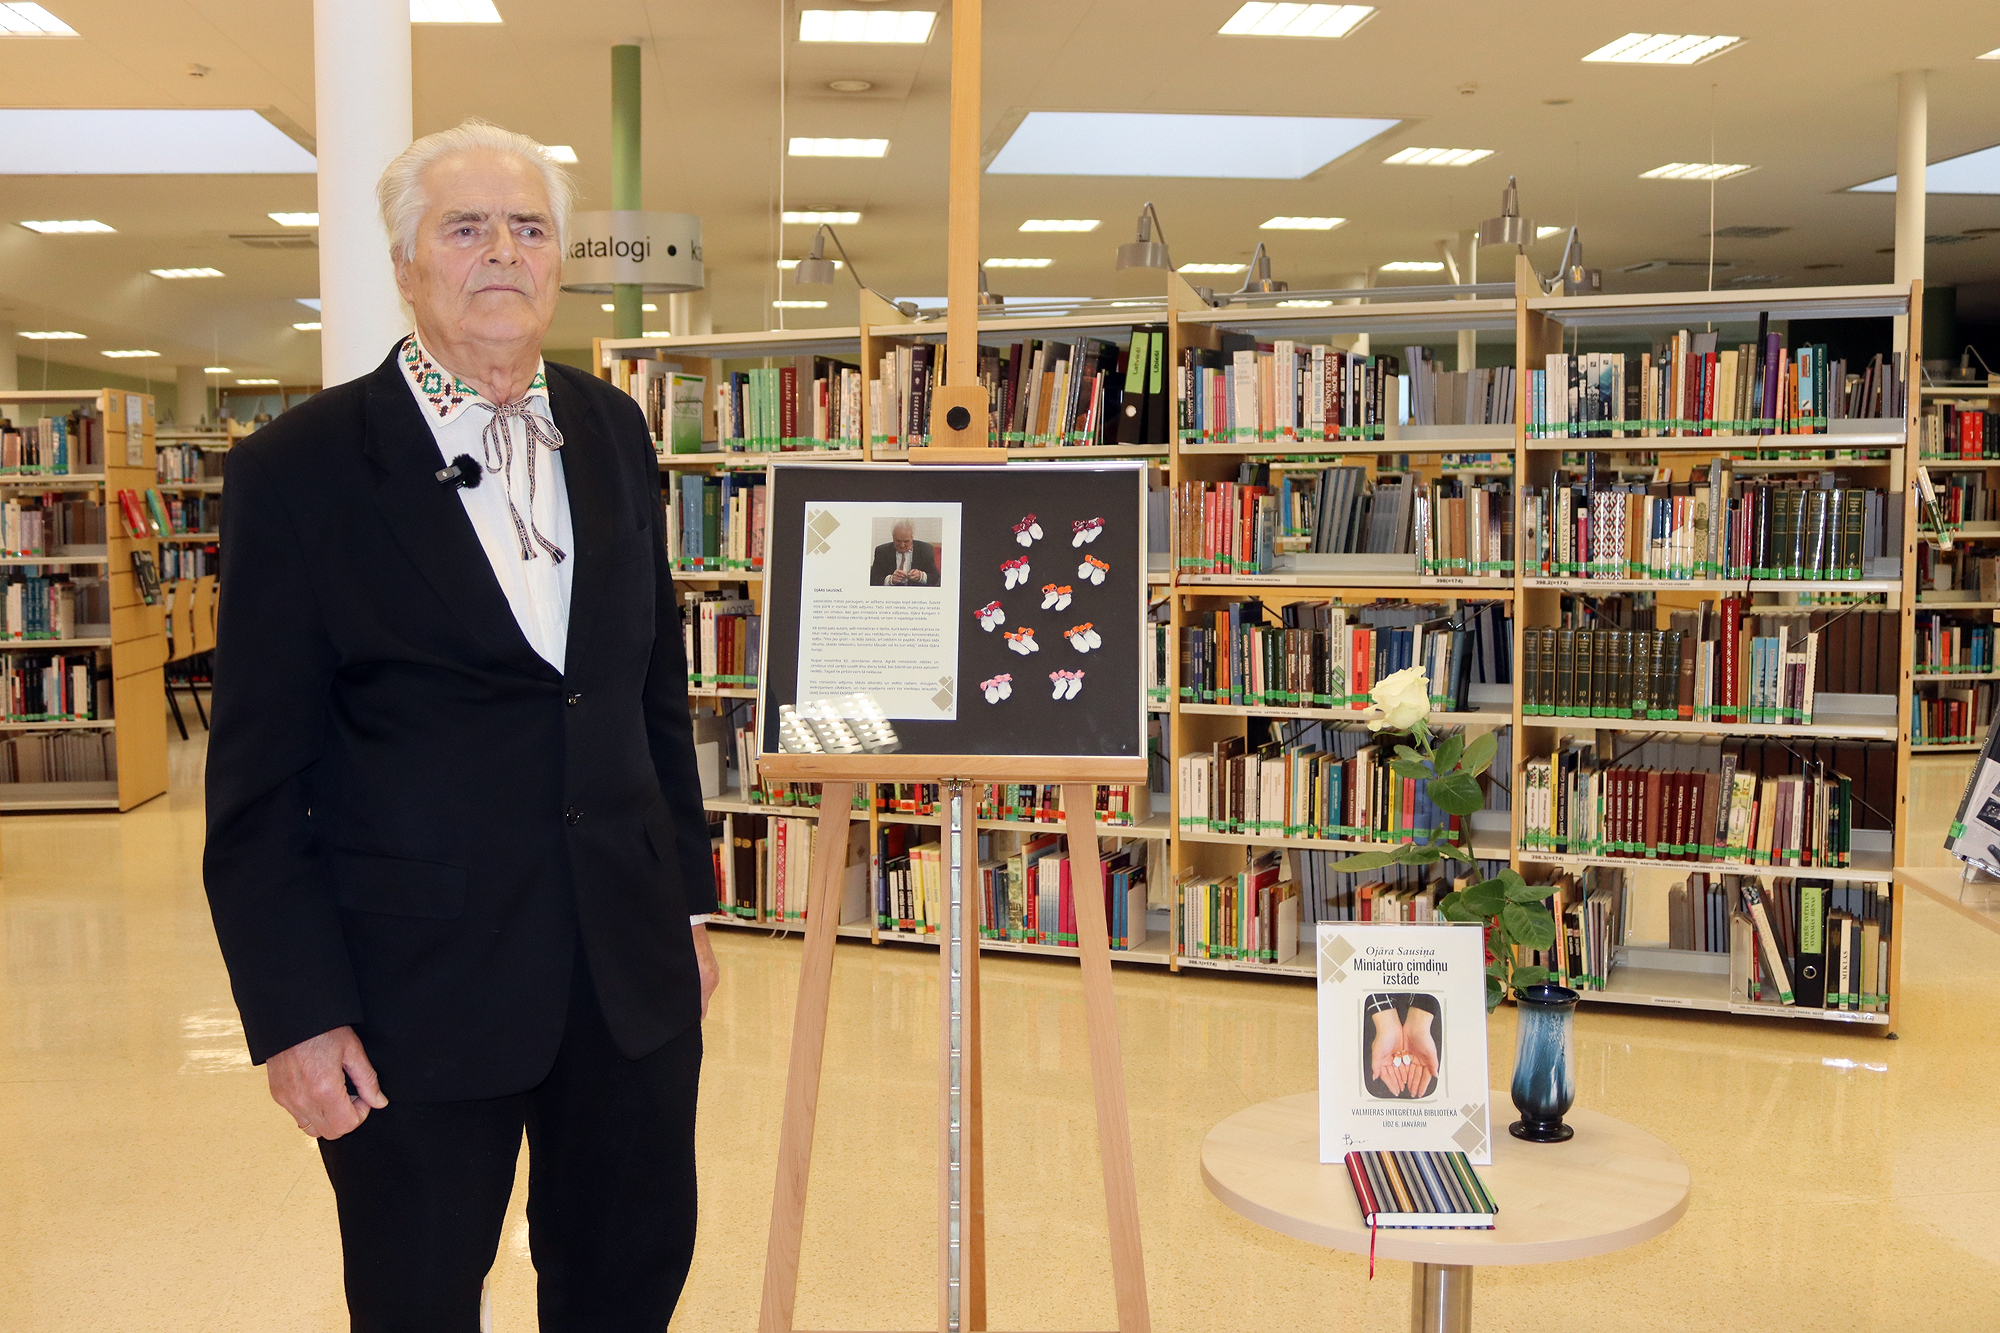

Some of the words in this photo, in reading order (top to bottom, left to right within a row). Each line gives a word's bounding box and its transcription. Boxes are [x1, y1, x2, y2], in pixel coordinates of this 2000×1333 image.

[1366, 946, 1394, 957] Ojāra
[1396, 946, 1434, 958] Sausiņa
[1354, 958, 1404, 972] Miniatūro
[1406, 959, 1448, 976] cimdiņu
[1383, 973, 1420, 985] izstāde
